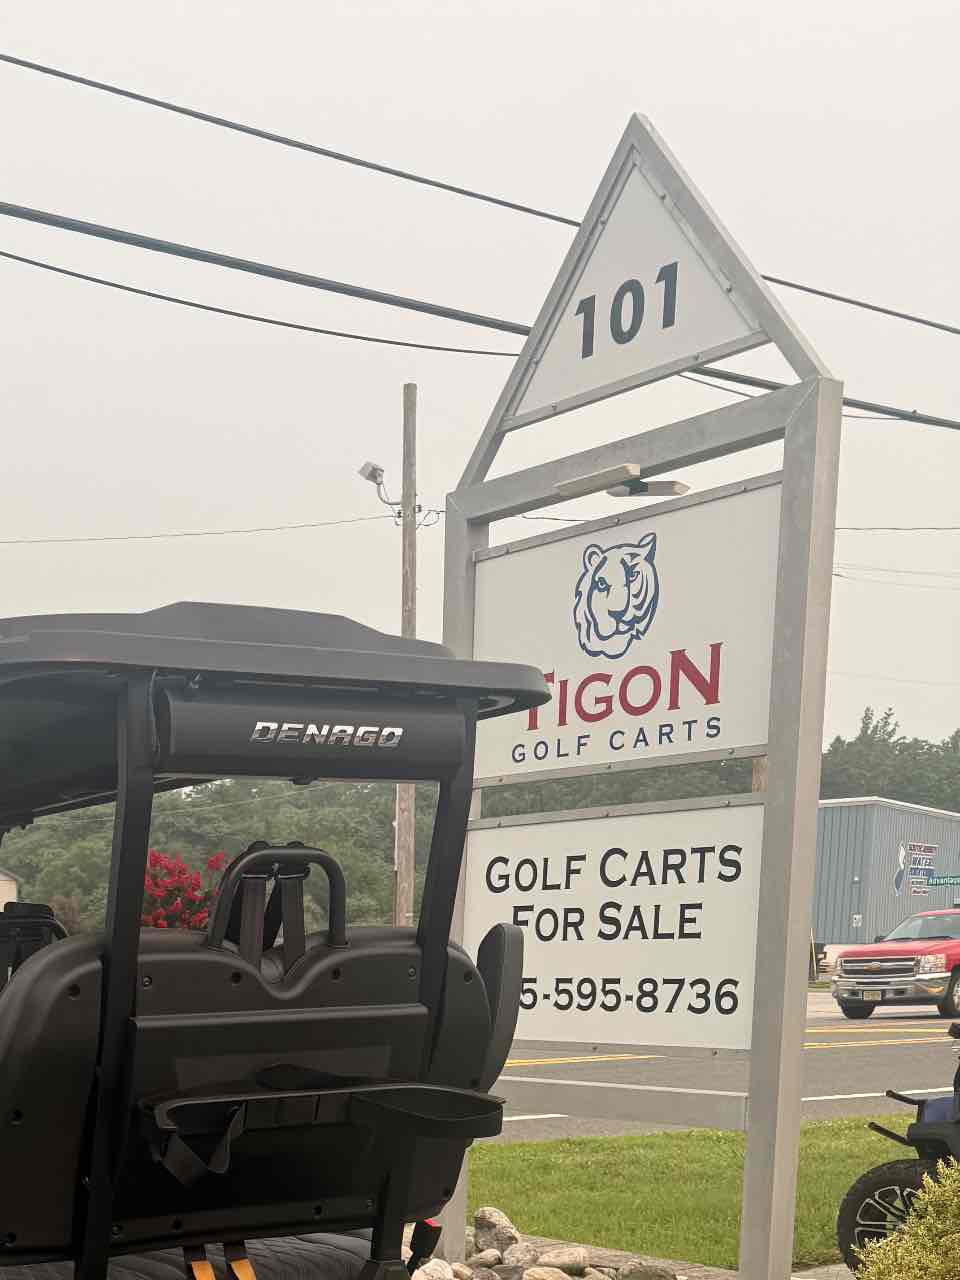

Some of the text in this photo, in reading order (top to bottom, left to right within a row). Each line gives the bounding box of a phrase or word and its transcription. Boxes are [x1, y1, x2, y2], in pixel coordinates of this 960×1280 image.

[575, 261, 678, 359] 101
[250, 721, 403, 748] DENAGO
[511, 716, 722, 764] GOLF CARTS
[485, 844, 743, 894] GOLF CARTS
[512, 900, 704, 942] FOR SALE
